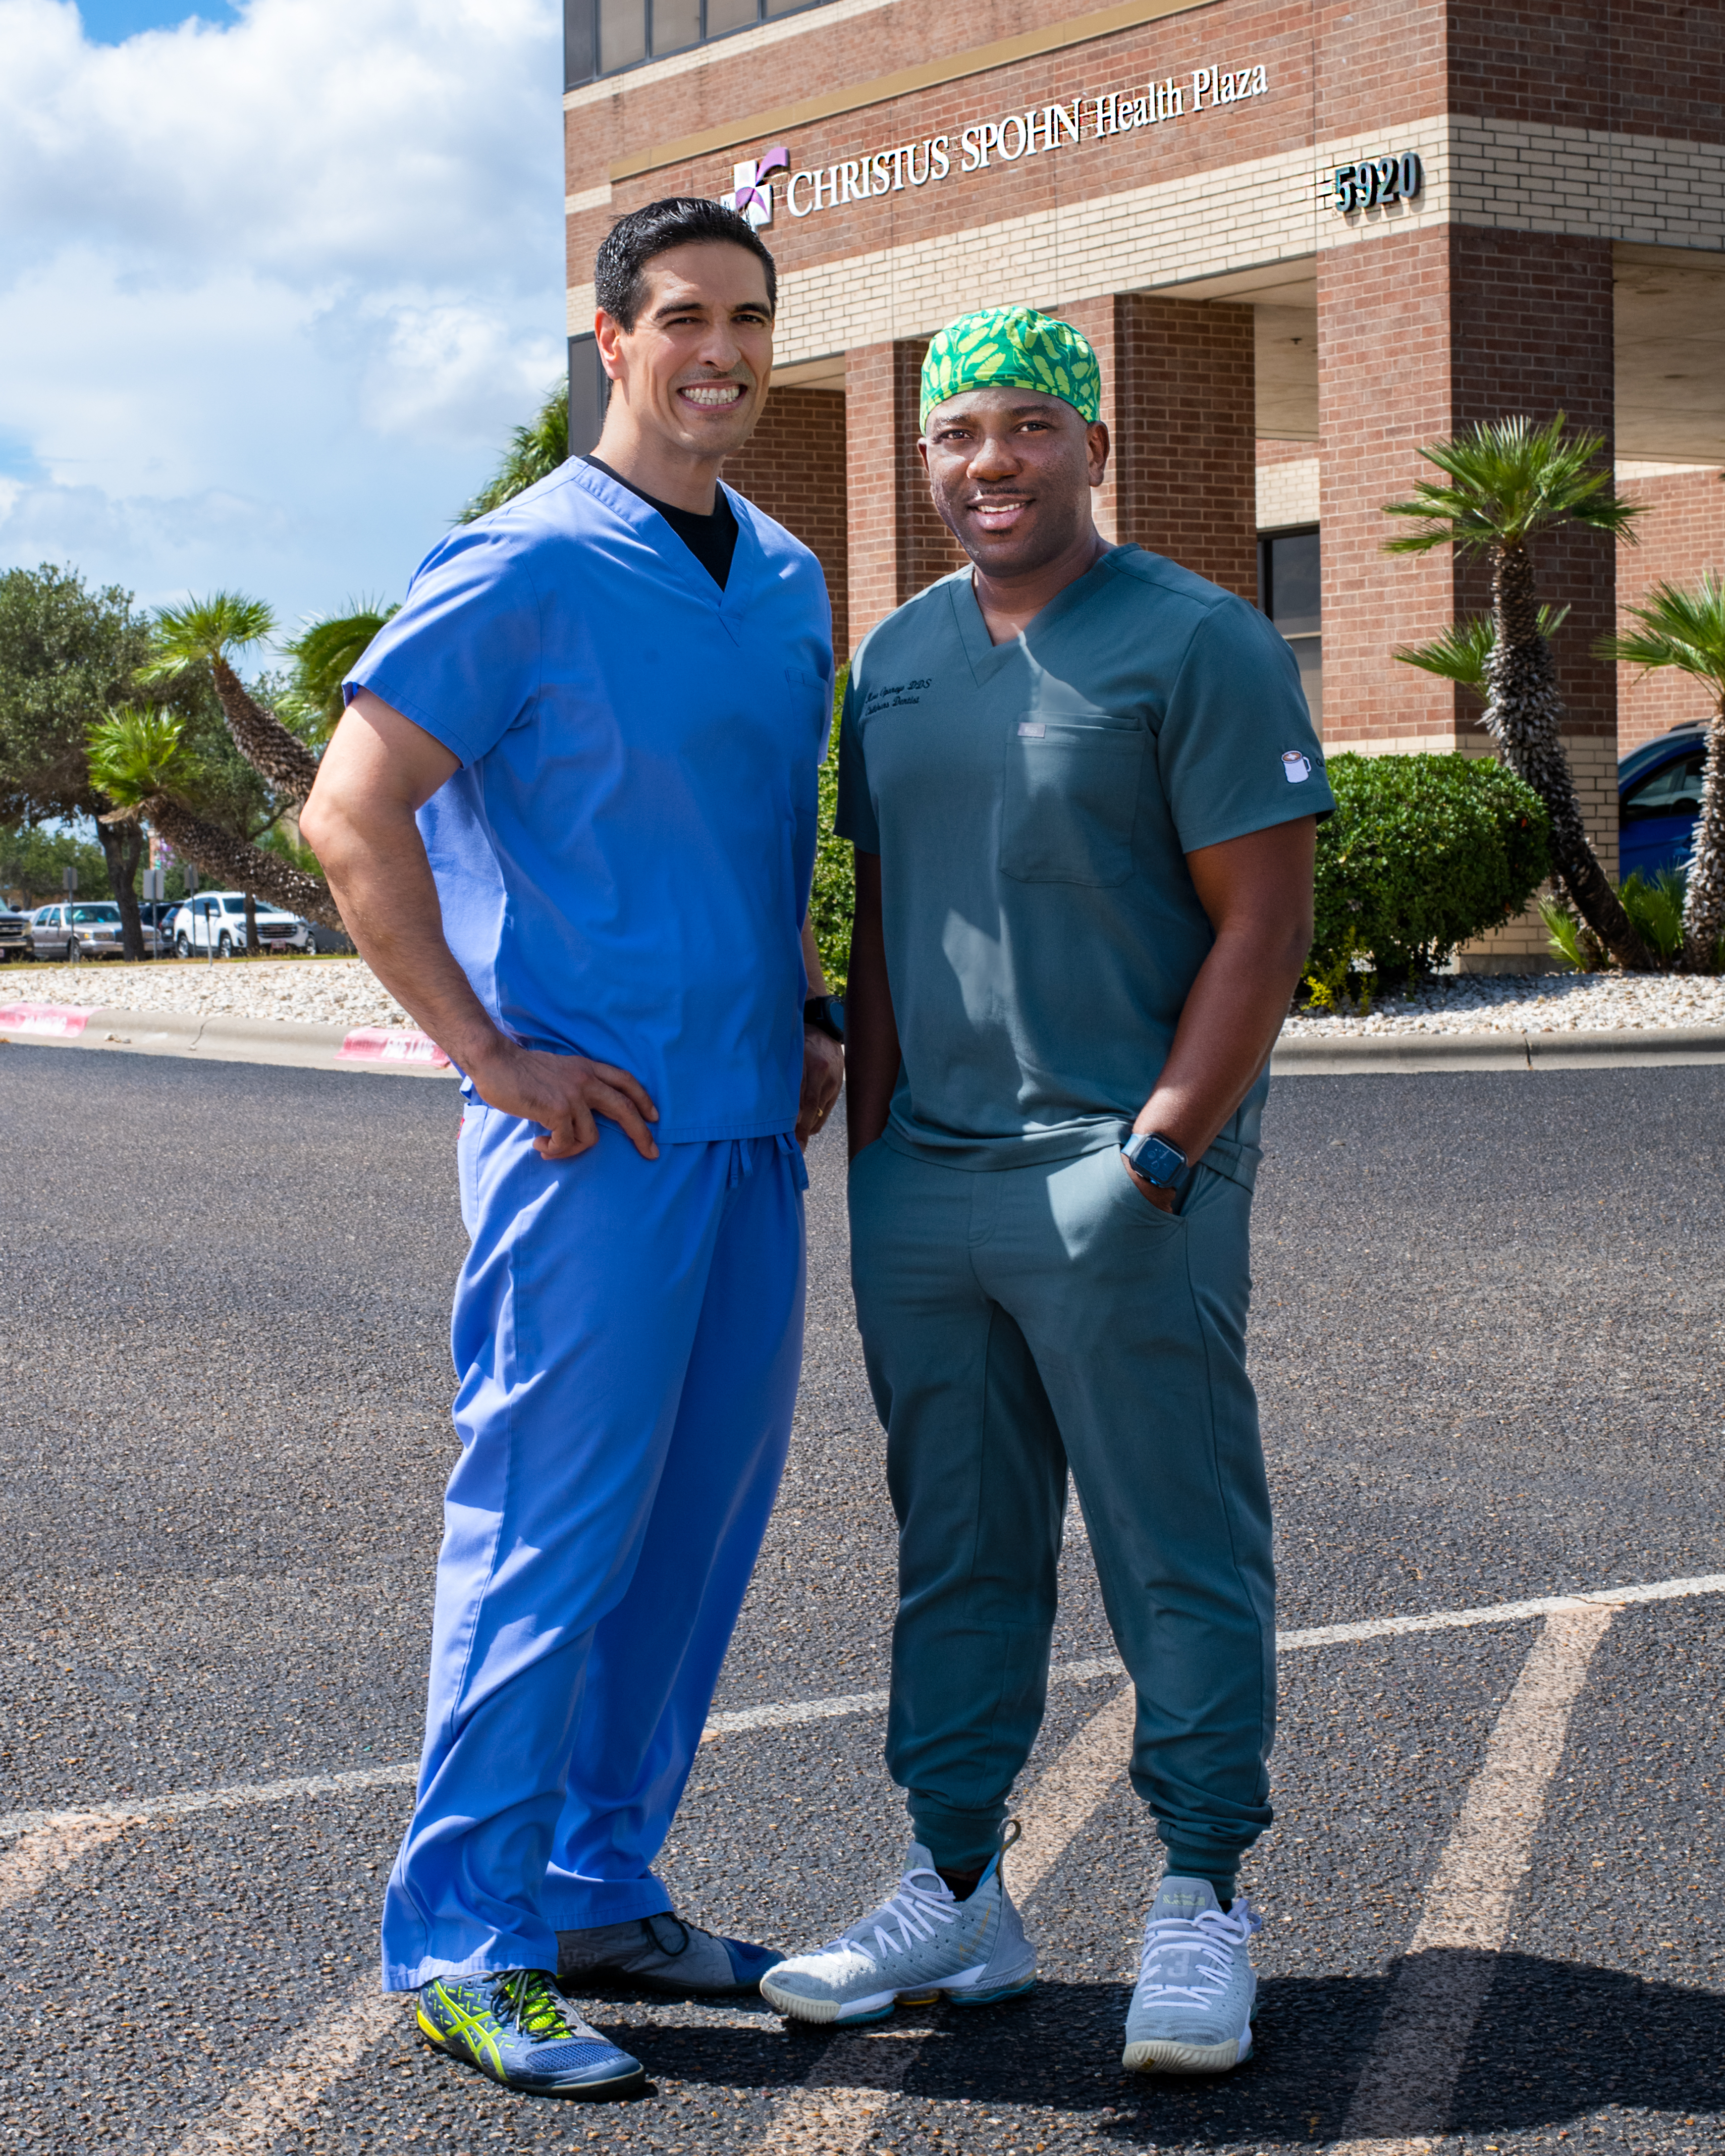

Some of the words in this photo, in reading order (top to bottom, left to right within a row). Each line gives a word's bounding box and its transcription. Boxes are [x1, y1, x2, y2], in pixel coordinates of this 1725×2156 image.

[787, 136, 950, 218] CHRISTUS
[961, 98, 1082, 172] SPOHN
[1095, 77, 1184, 138] Health
[1191, 64, 1269, 112] Plaza
[1335, 151, 1421, 212] 5920
